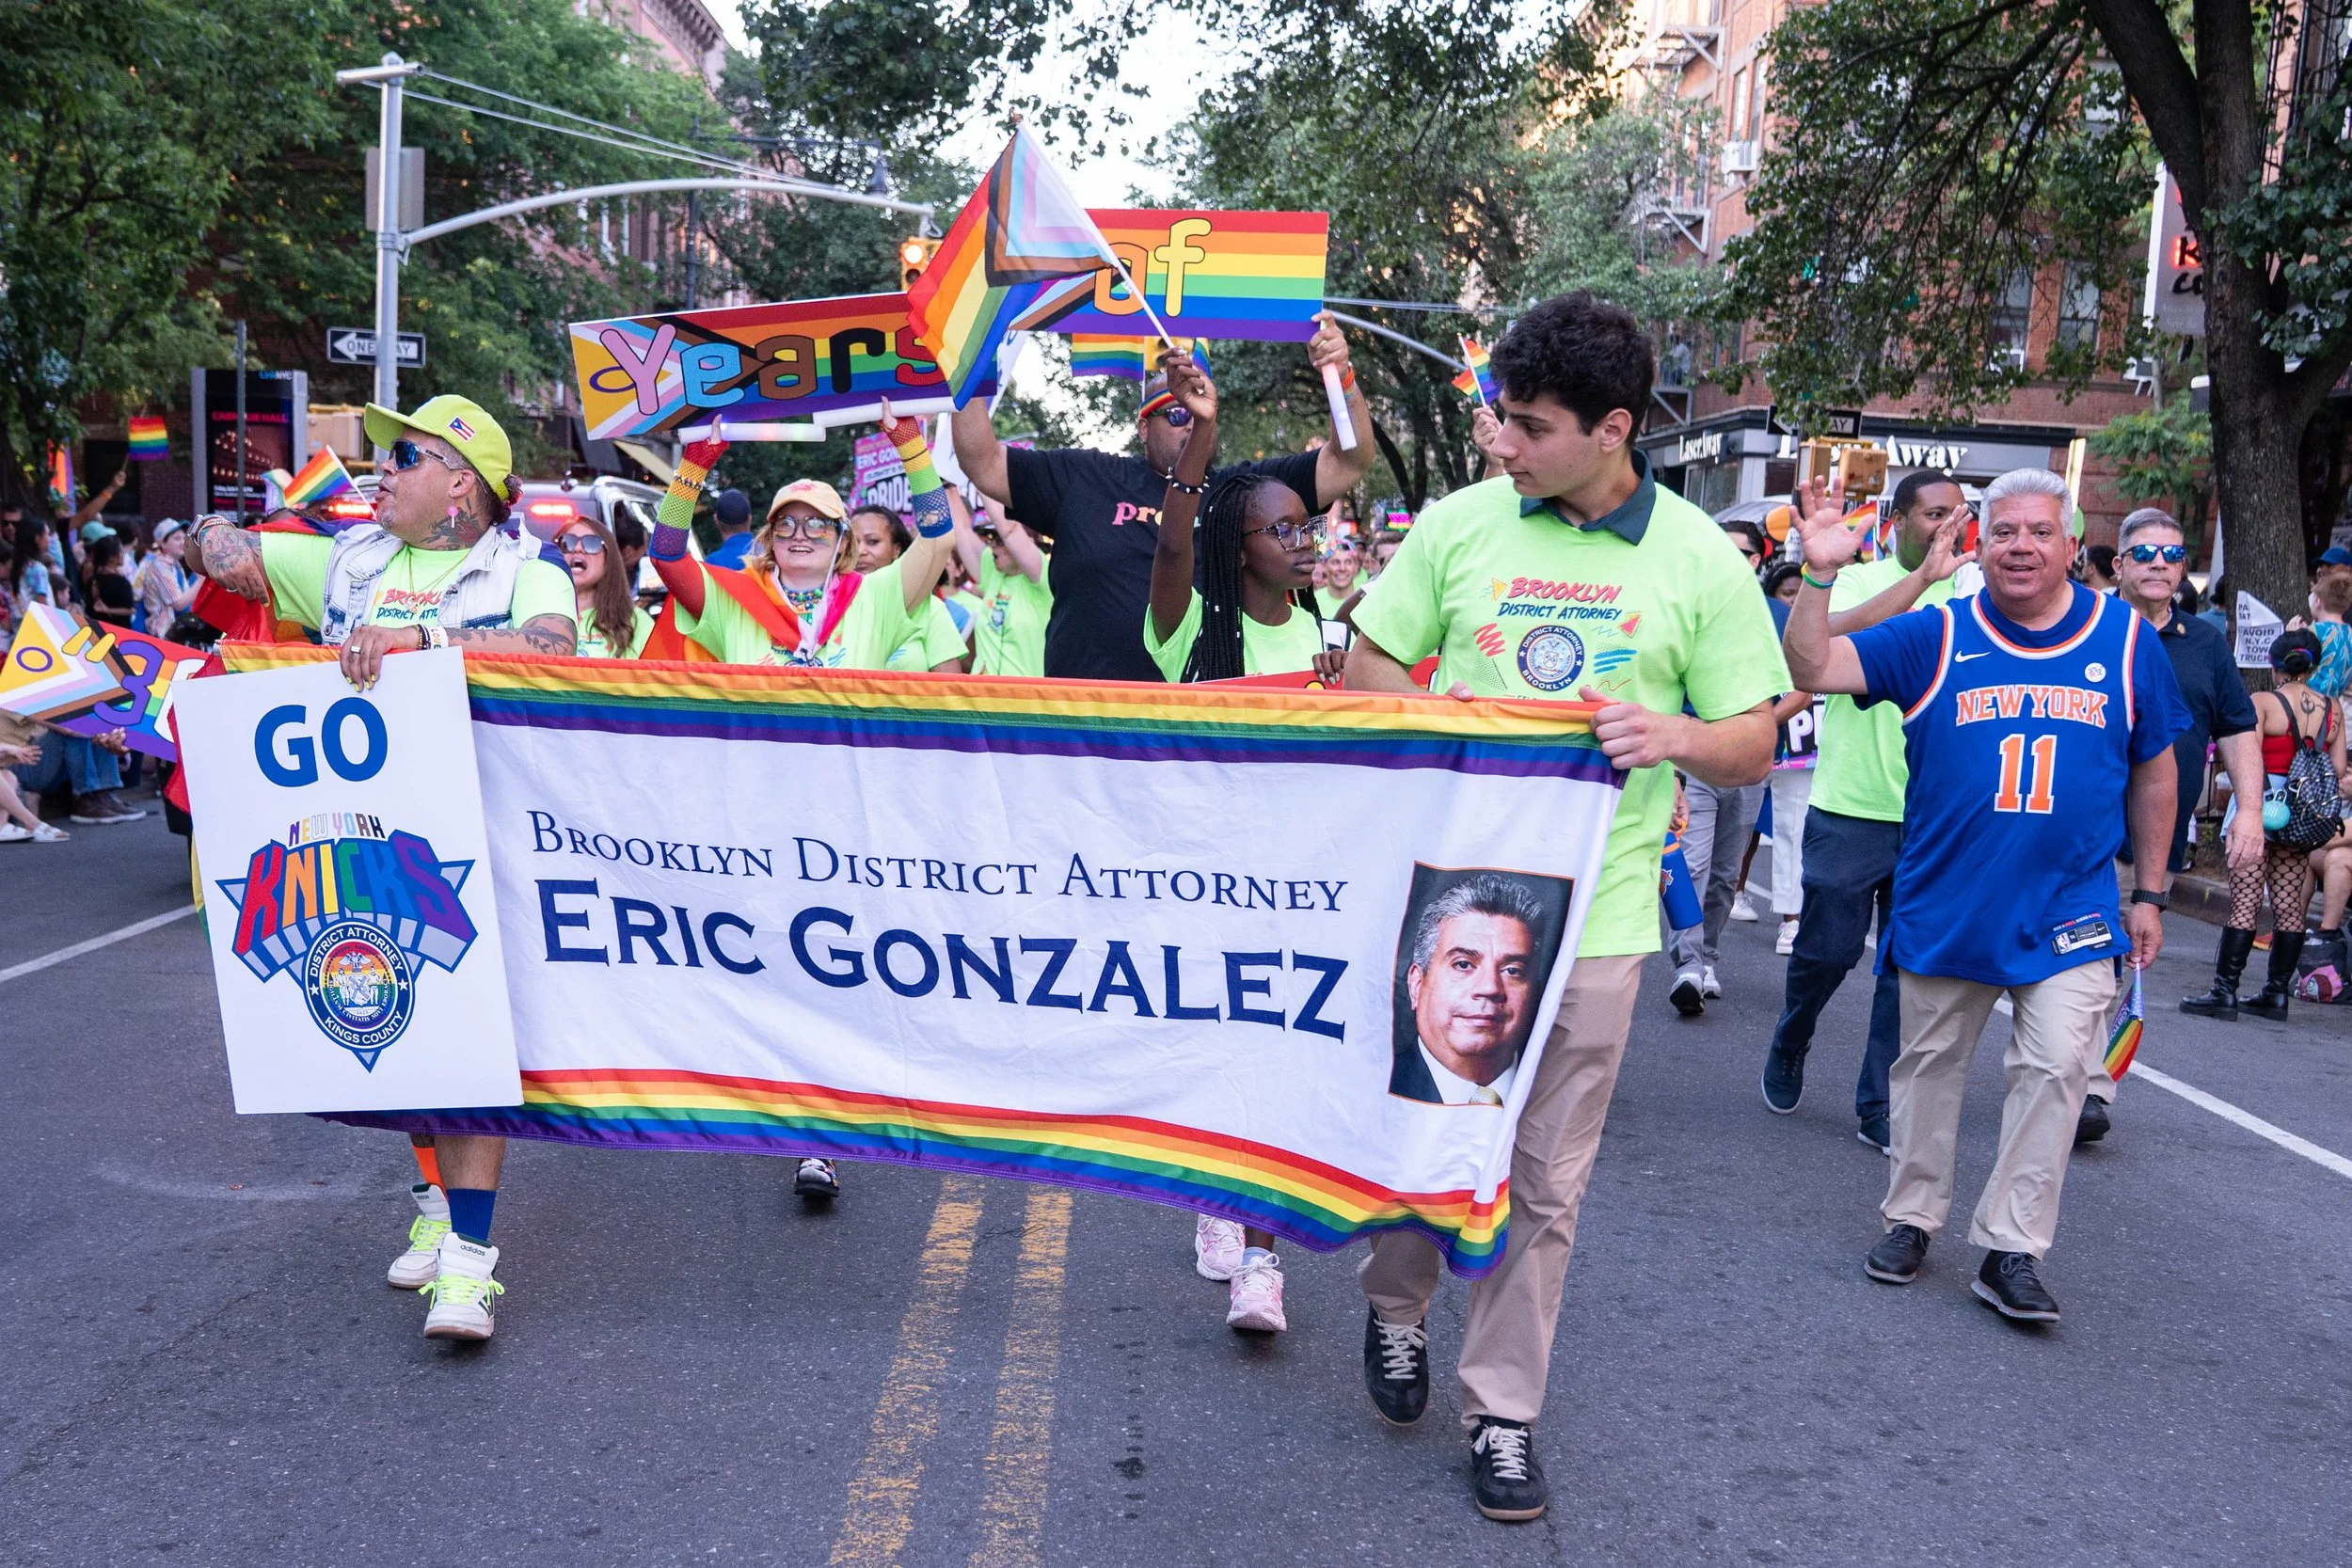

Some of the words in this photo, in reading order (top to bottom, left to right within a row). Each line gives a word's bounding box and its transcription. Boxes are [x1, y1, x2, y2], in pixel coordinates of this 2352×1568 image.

[1093, 217, 1213, 318] of
[347, 341, 374, 355] ONE
[599, 324, 947, 416] Years
[382, 588, 442, 607] BROOKL
[1507, 577, 1623, 604] BROOKLYN
[376, 608, 415, 620] DISTRICT
[1497, 602, 1556, 618] DISTRICT
[1557, 606, 1622, 621] ATTORNEY
[1522, 626, 1553, 648] DISTRICT
[1553, 626, 1583, 656] ATTORNEY
[2243, 628, 2275, 637] AVOID
[1521, 669, 1572, 690] BROOKLYN
[1956, 686, 2026, 727] NEW
[2026, 685, 2108, 729] YORK
[255, 697, 388, 787] GO
[1994, 734, 2058, 814] 11
[289, 814, 329, 847] NEW
[332, 813, 386, 839] YORK
[234, 833, 471, 957] KNICKS
[310, 928, 344, 977] DISTRICT
[347, 927, 404, 971] ATTORNEY
[325, 1016, 360, 1043] KINGS
[361, 1010, 404, 1044] COUNTY
[460, 1243, 485, 1257] adidas
